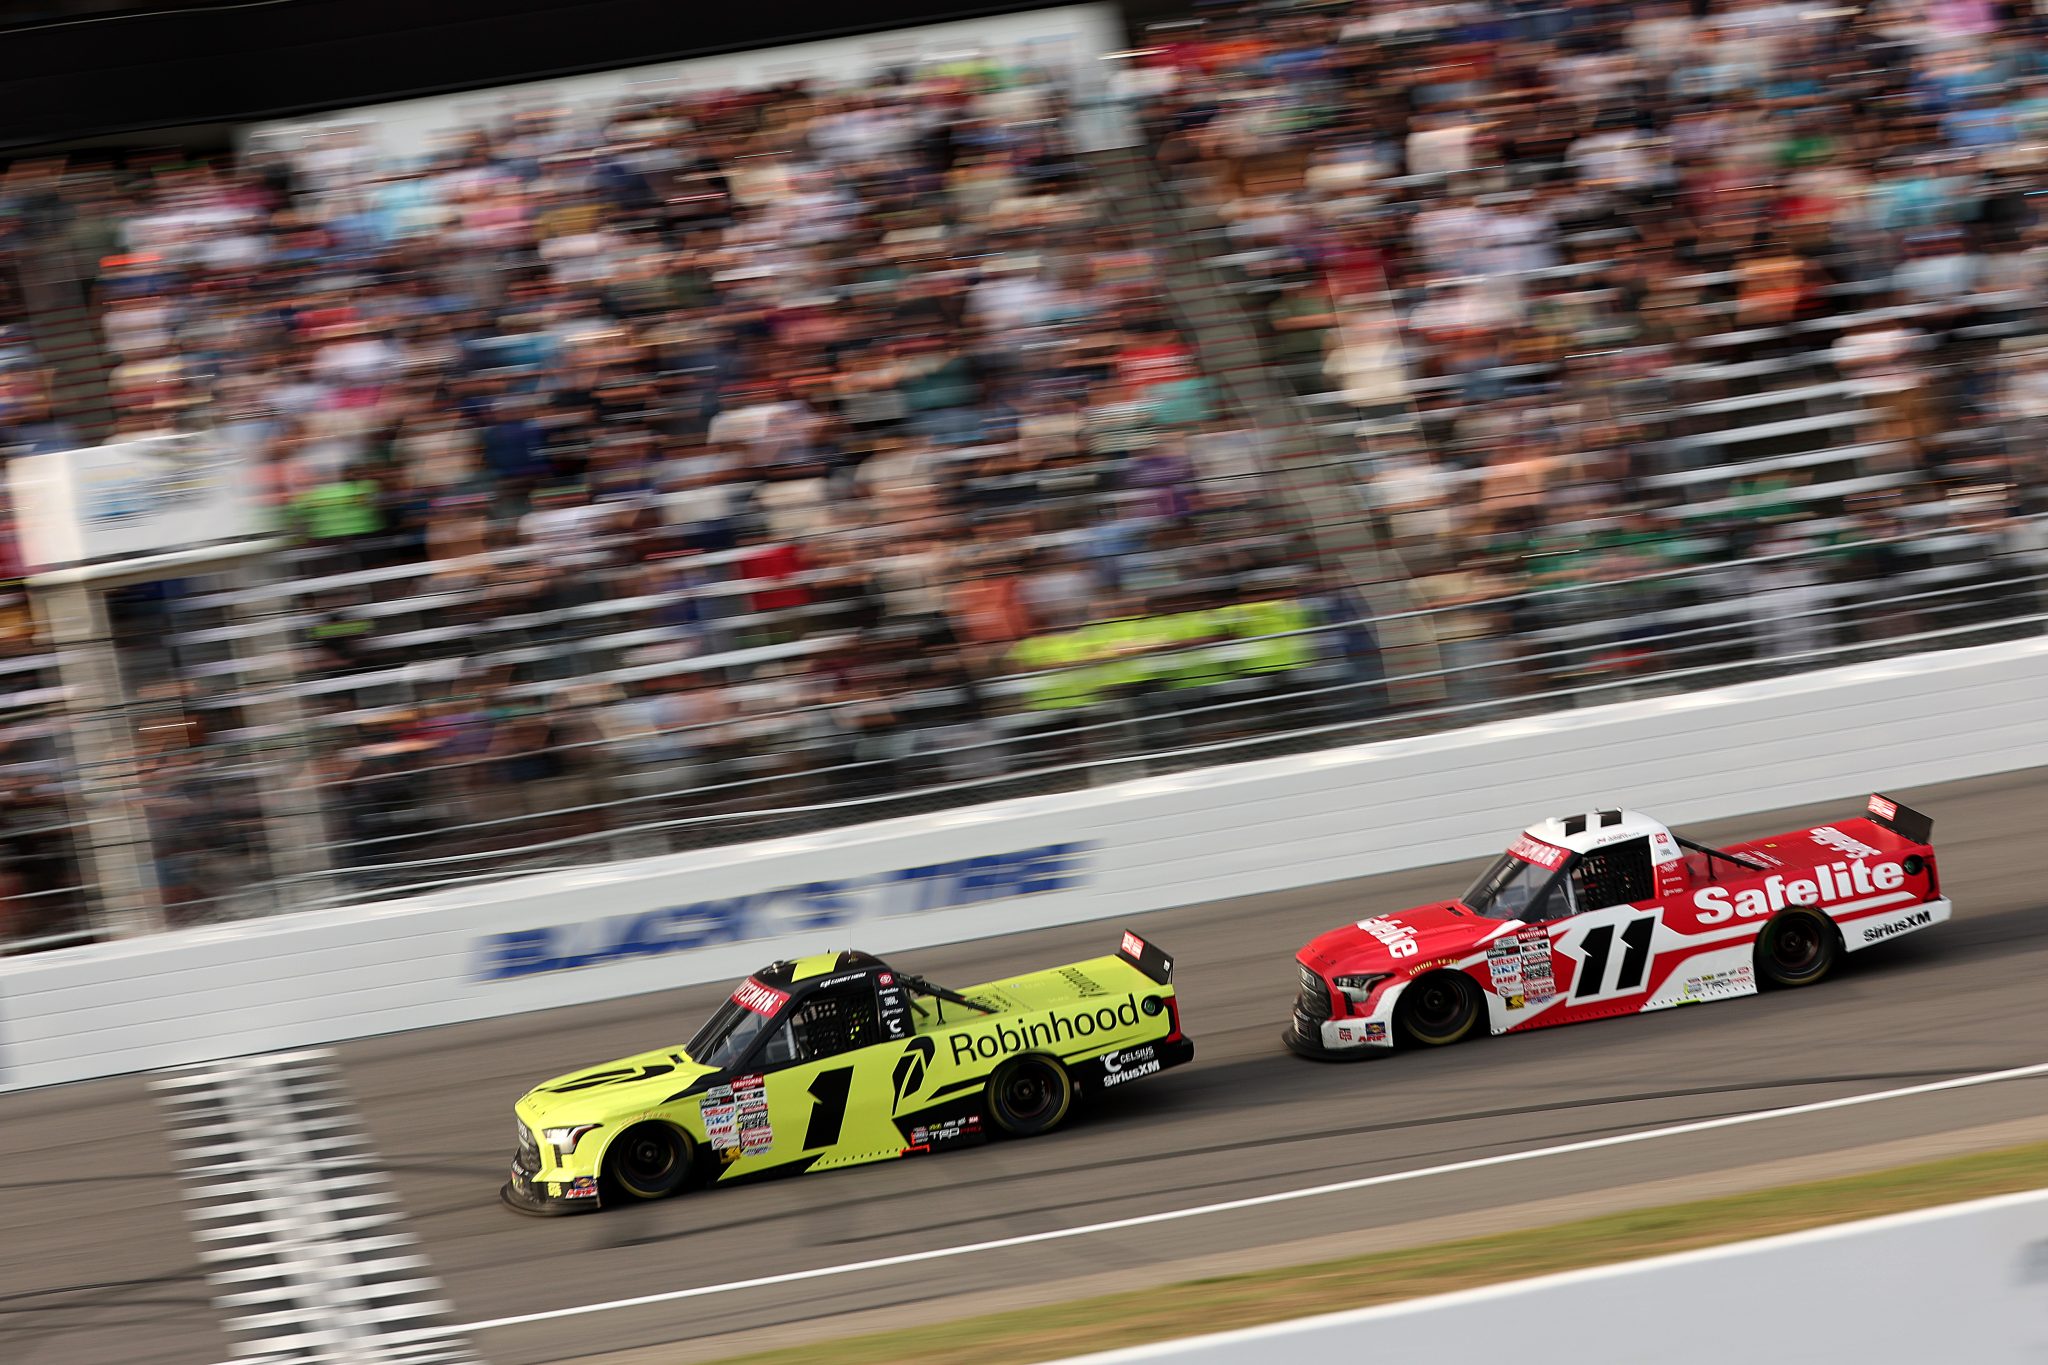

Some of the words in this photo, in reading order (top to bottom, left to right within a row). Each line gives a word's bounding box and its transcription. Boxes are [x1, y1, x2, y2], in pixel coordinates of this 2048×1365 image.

[1693, 858, 1905, 925] Safelite
[1575, 916, 1656, 998] 11
[1863, 910, 1933, 943] SiriusXM
[950, 993, 1140, 1066] Robinhood
[1120, 1046, 1155, 1064] CELSIUS
[1103, 1060, 1160, 1087] SiriusXM
[802, 1065, 855, 1152] 1
